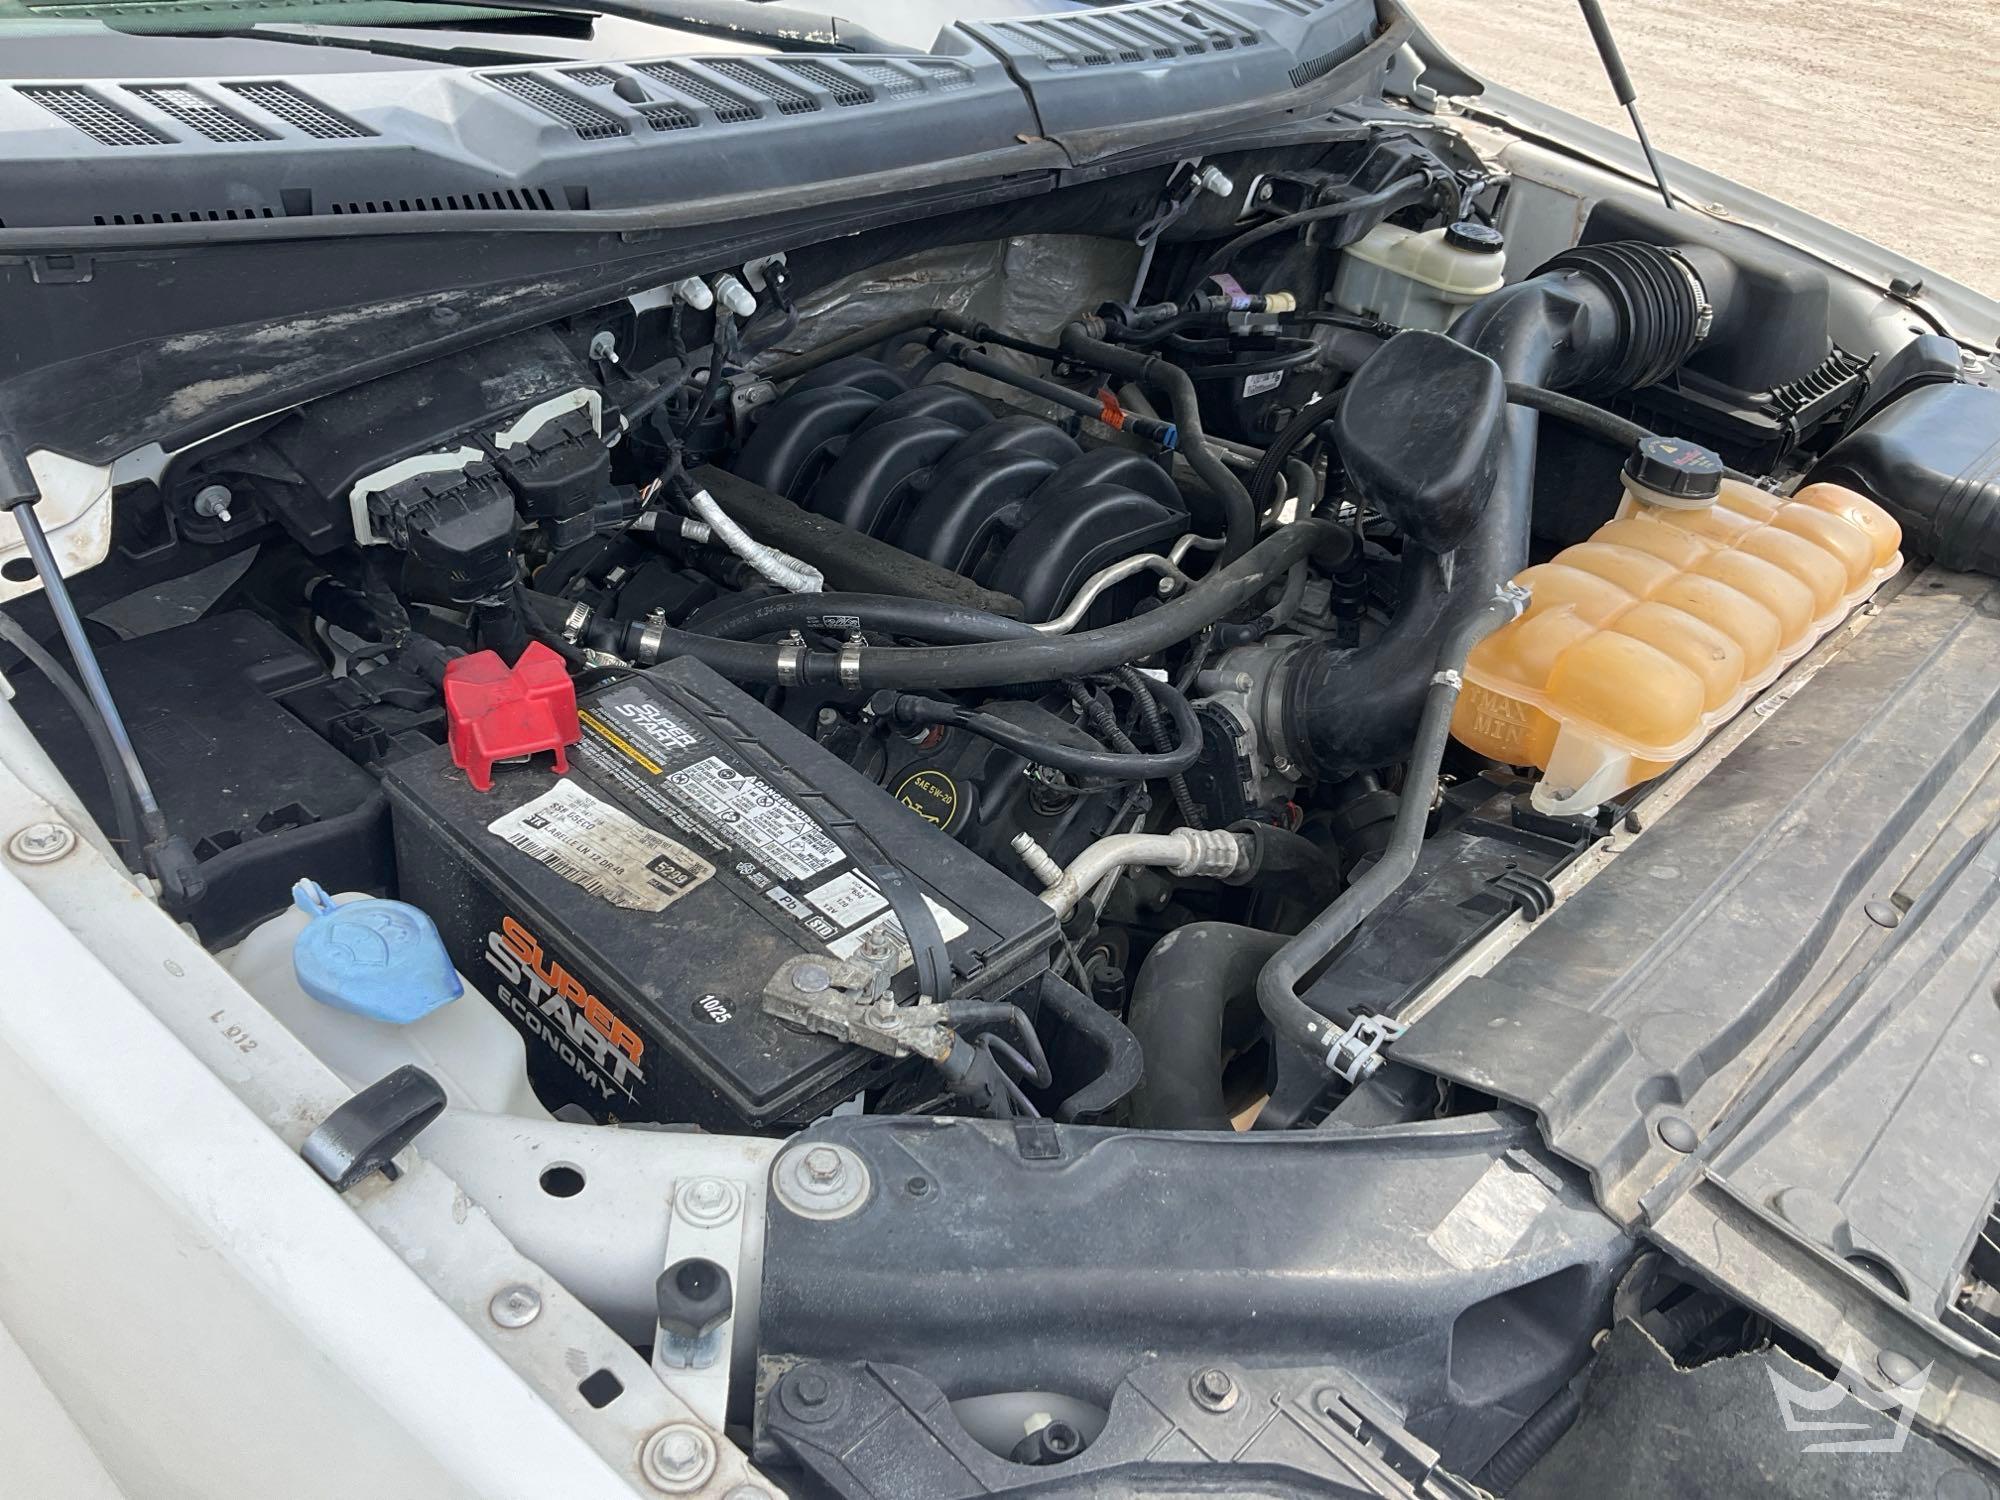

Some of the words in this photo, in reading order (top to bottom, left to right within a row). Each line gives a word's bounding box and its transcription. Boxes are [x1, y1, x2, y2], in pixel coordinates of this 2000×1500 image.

[614, 703, 686, 748] START
[641, 703, 697, 745] SUPER
[914, 777, 930, 791] SAE
[928, 786, 952, 804] 5W-20
[654, 861, 689, 884] 5299
[779, 896, 797, 910] Pb
[485, 931, 647, 1085] START
[502, 916, 645, 1067] SUPER
[699, 994, 732, 1024] 10/25
[498, 984, 616, 1101] ECONOMY
